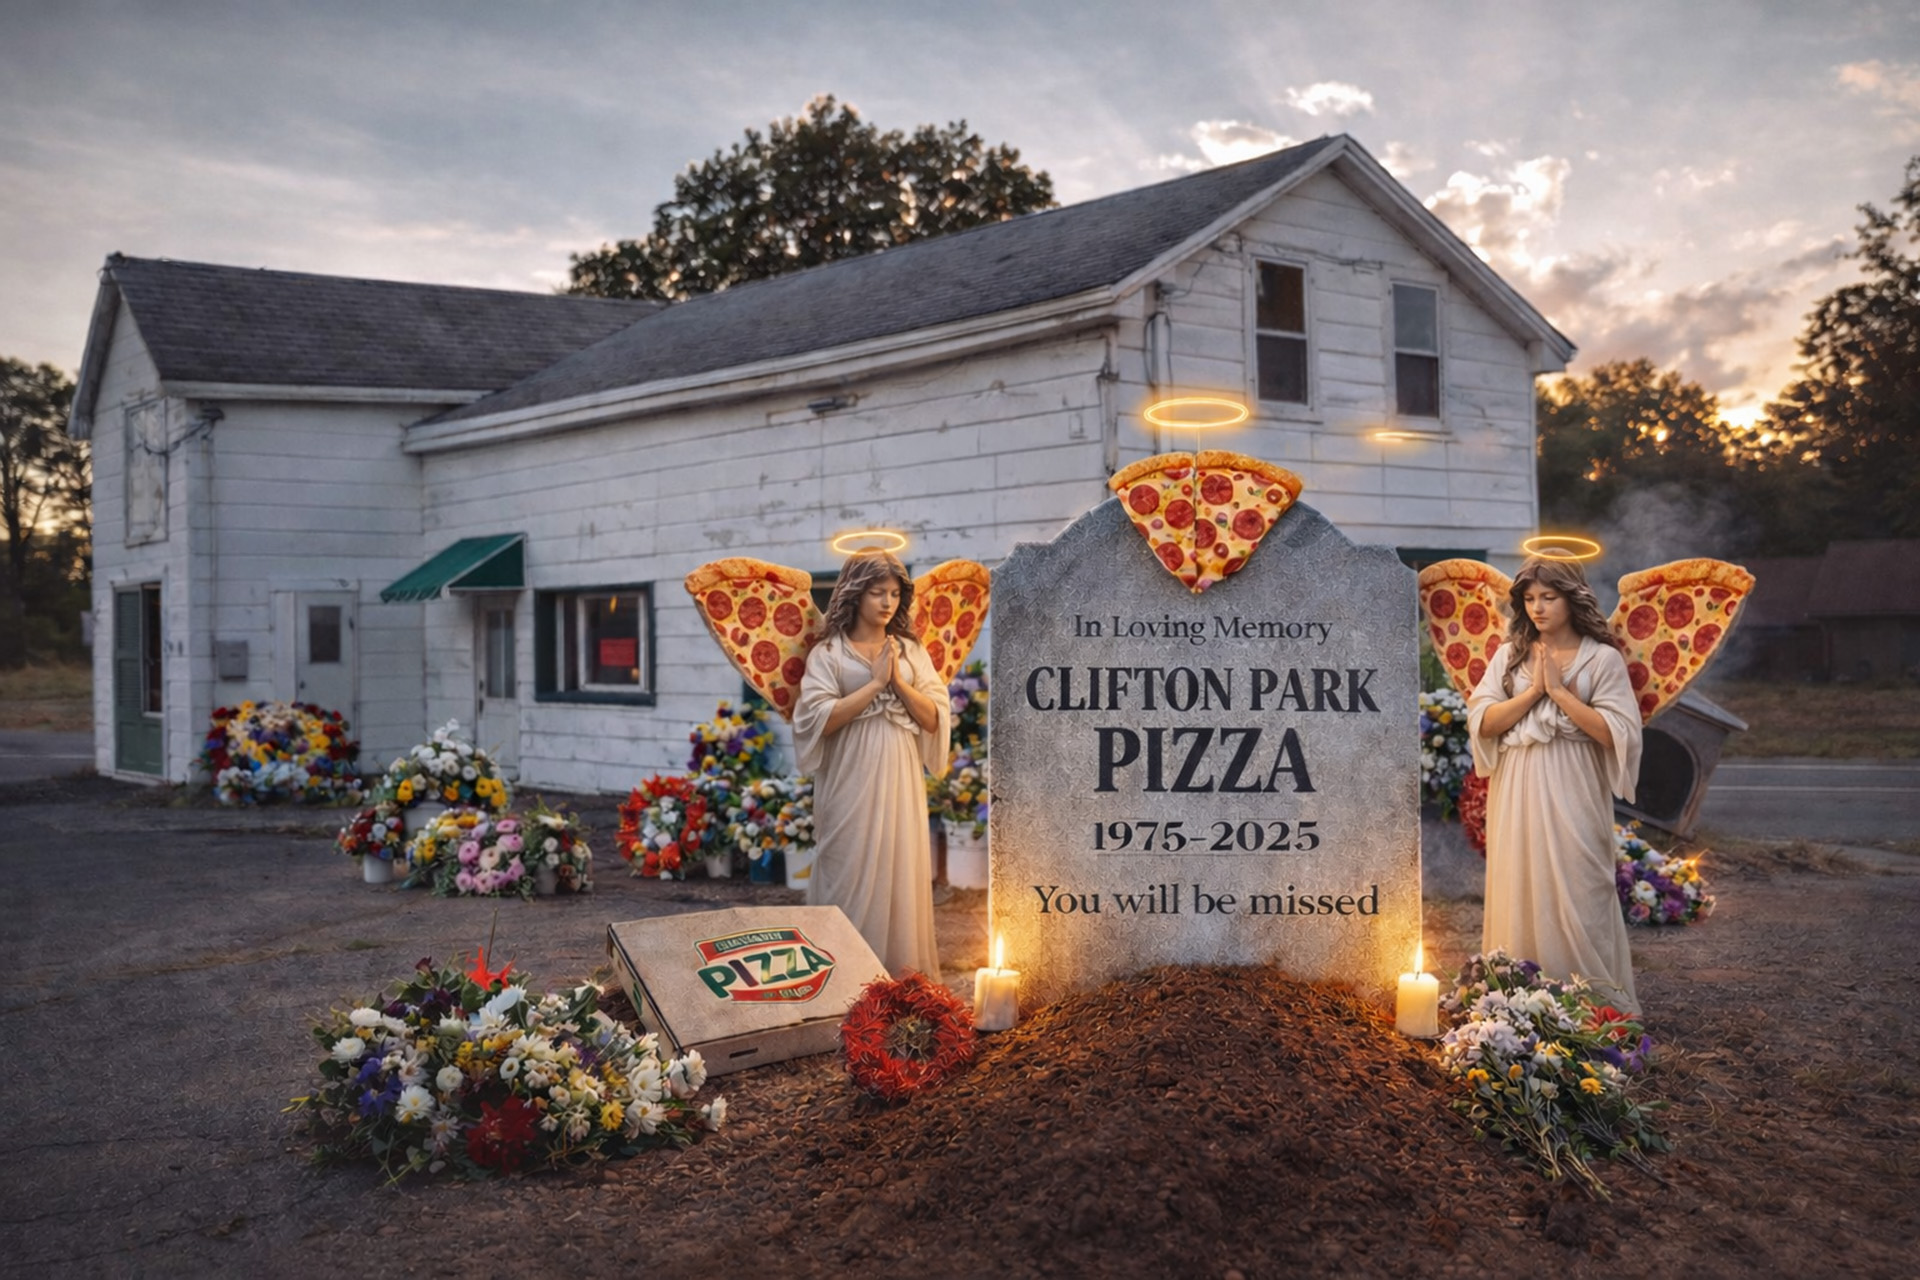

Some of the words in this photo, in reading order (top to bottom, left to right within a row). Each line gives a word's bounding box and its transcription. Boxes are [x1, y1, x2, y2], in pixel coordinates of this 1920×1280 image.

[1074, 614, 1102, 638] In
[1113, 614, 1207, 646] Loving
[1214, 616, 1334, 646] Memory
[1026, 666, 1232, 712] CLIFTON
[1249, 667, 1381, 713] PARK
[1093, 726, 1316, 793] PIZZA
[1034, 885, 1101, 914] You
[1113, 884, 1180, 914] will
[1193, 884, 1237, 915] be
[1250, 884, 1380, 915] missed
[697, 945, 834, 999] PIZZA
